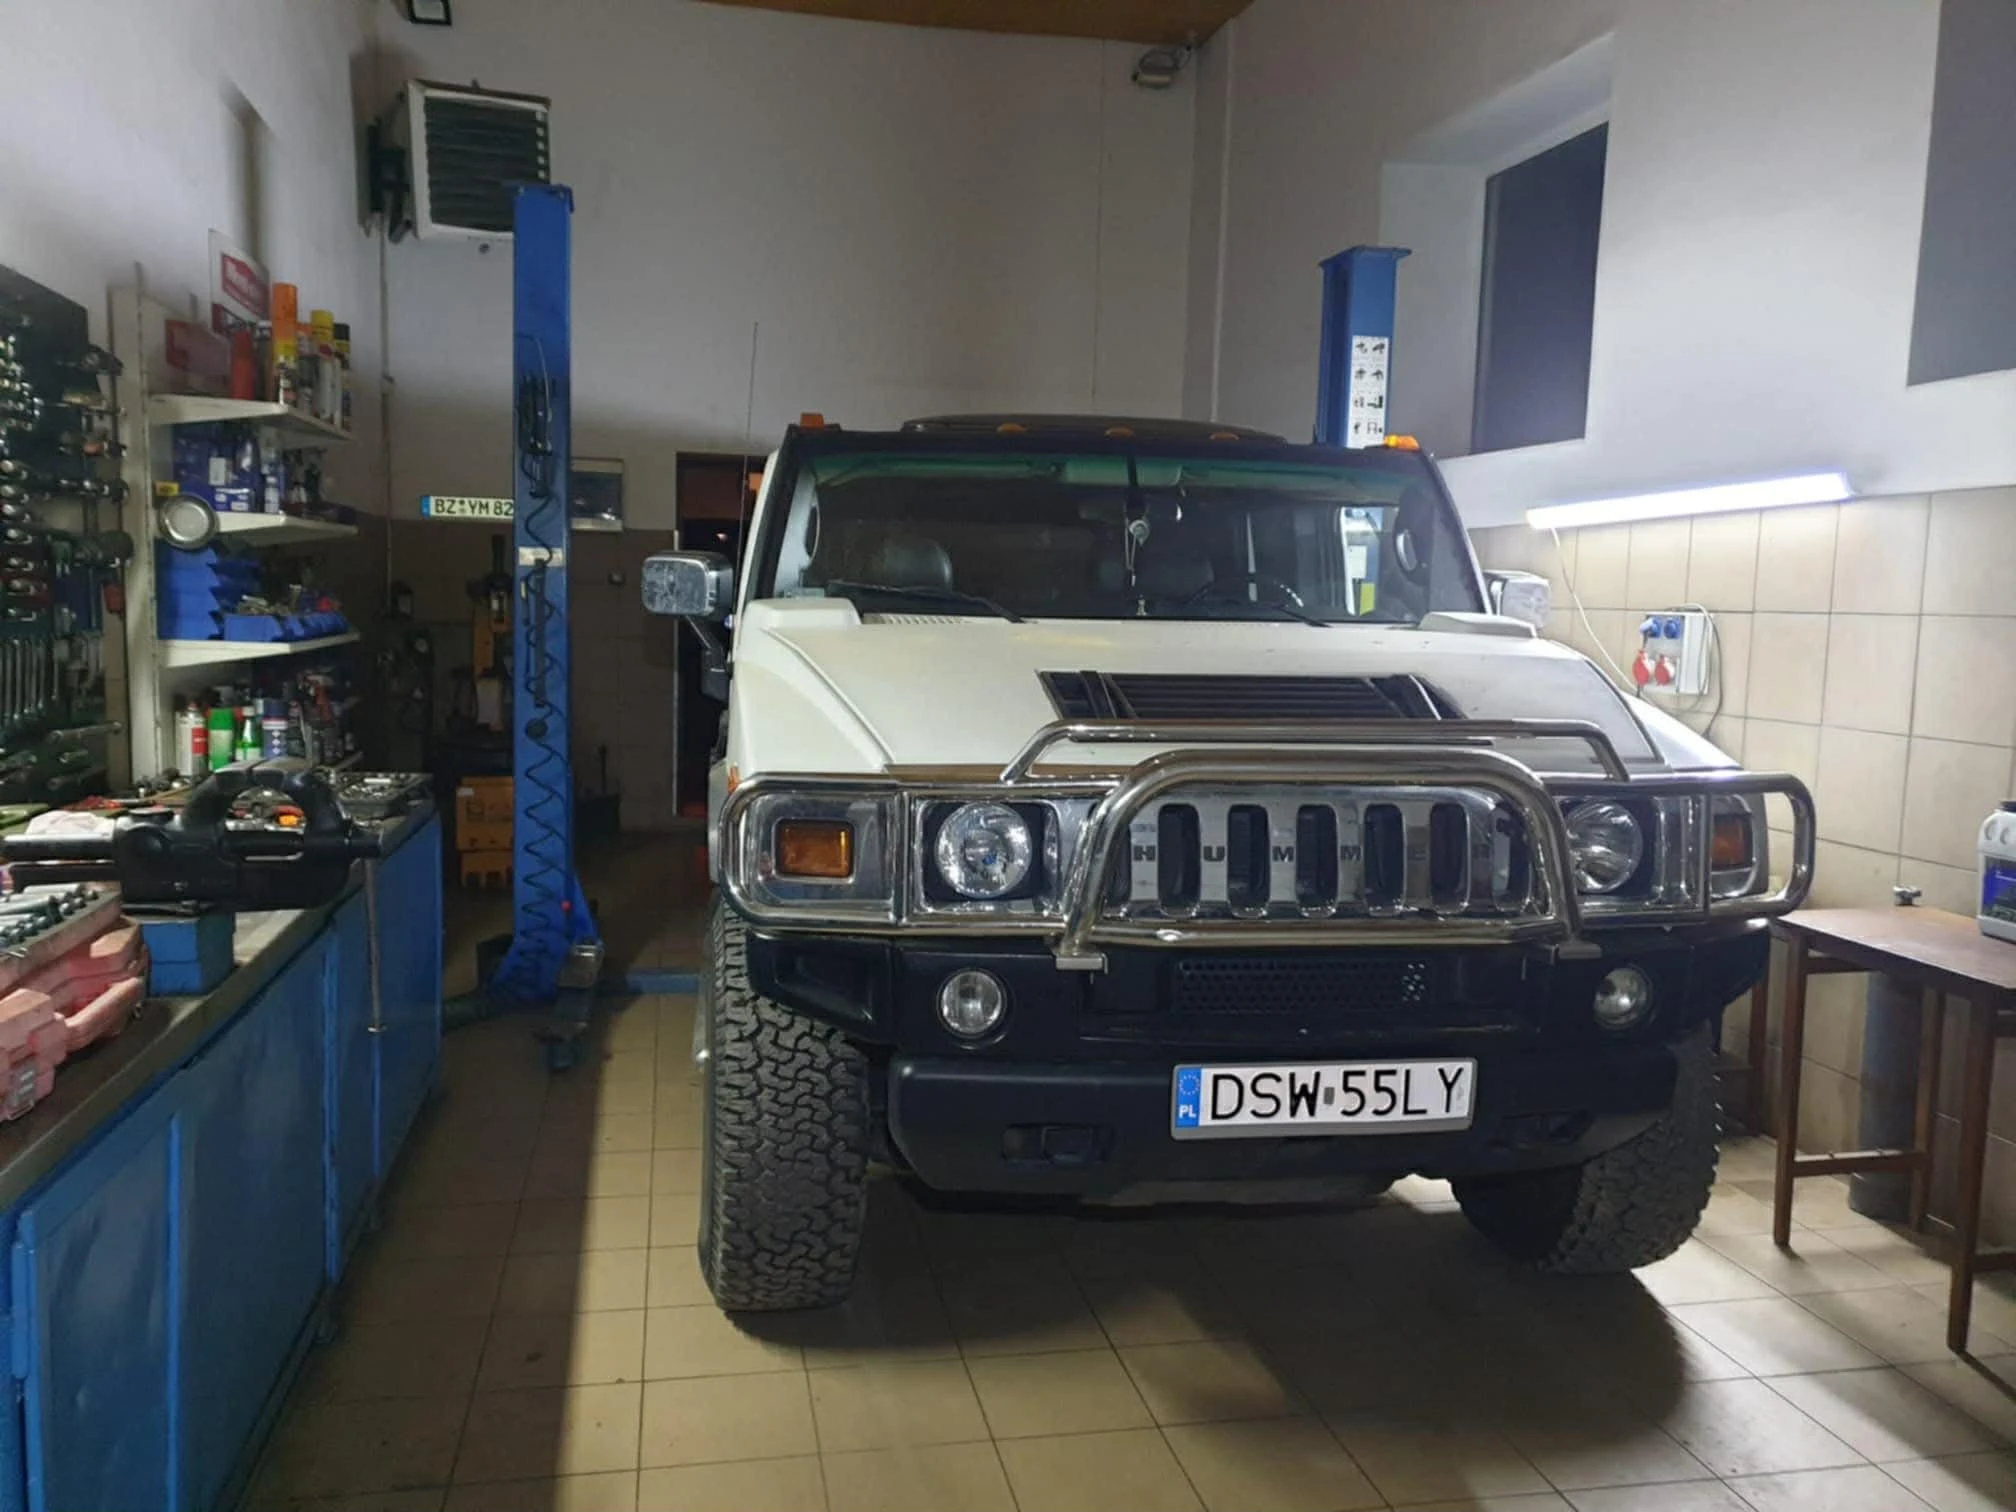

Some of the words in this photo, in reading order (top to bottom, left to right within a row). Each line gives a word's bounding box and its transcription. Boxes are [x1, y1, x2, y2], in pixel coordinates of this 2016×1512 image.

[435, 498, 456, 514] BZ
[468, 499, 489, 515] YM
[494, 500, 514, 516] 82
[1211, 1071, 1321, 1120] DSW
[1340, 1067, 1464, 1116] 55LY
[1179, 1105, 1196, 1118] PL
